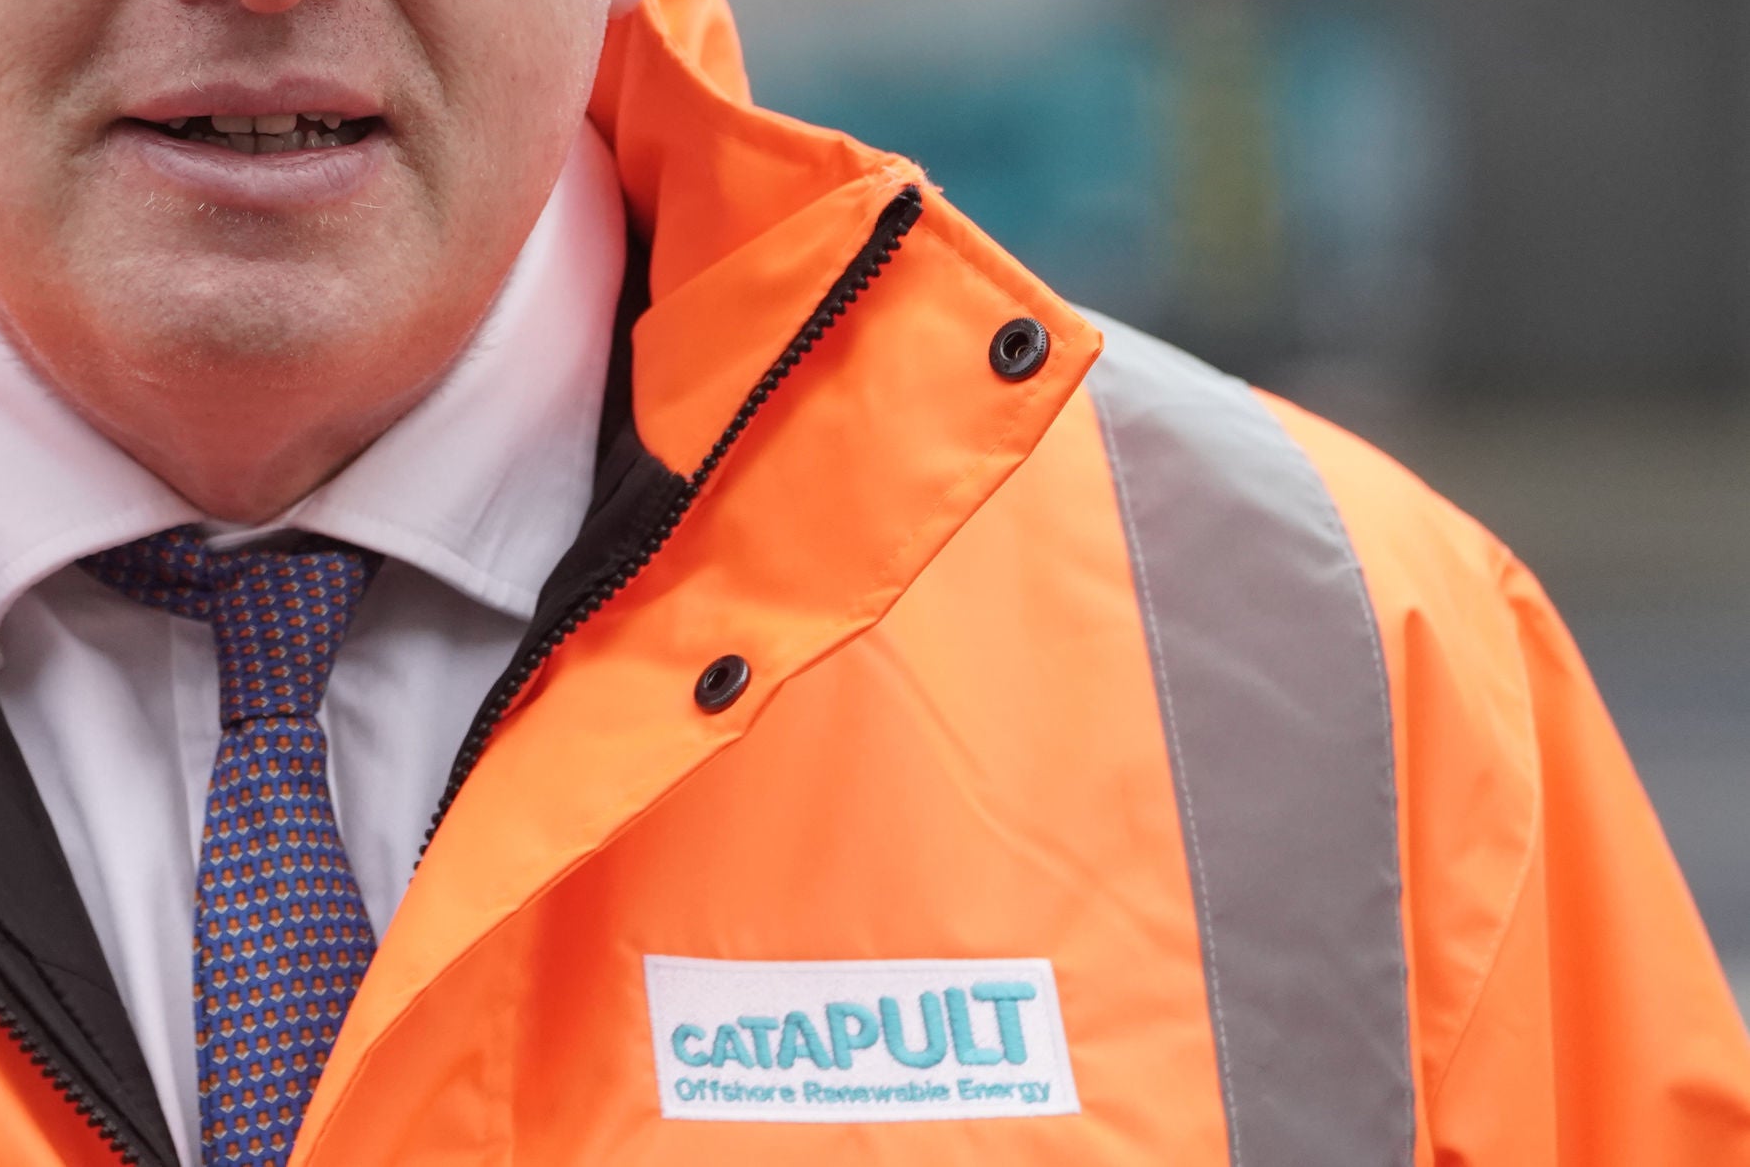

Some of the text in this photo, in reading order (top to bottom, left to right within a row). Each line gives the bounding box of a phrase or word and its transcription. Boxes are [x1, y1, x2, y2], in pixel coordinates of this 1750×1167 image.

[671, 981, 1037, 1070] CATAPULT
[674, 1077, 1051, 1104] Offshore Renewable Energy
